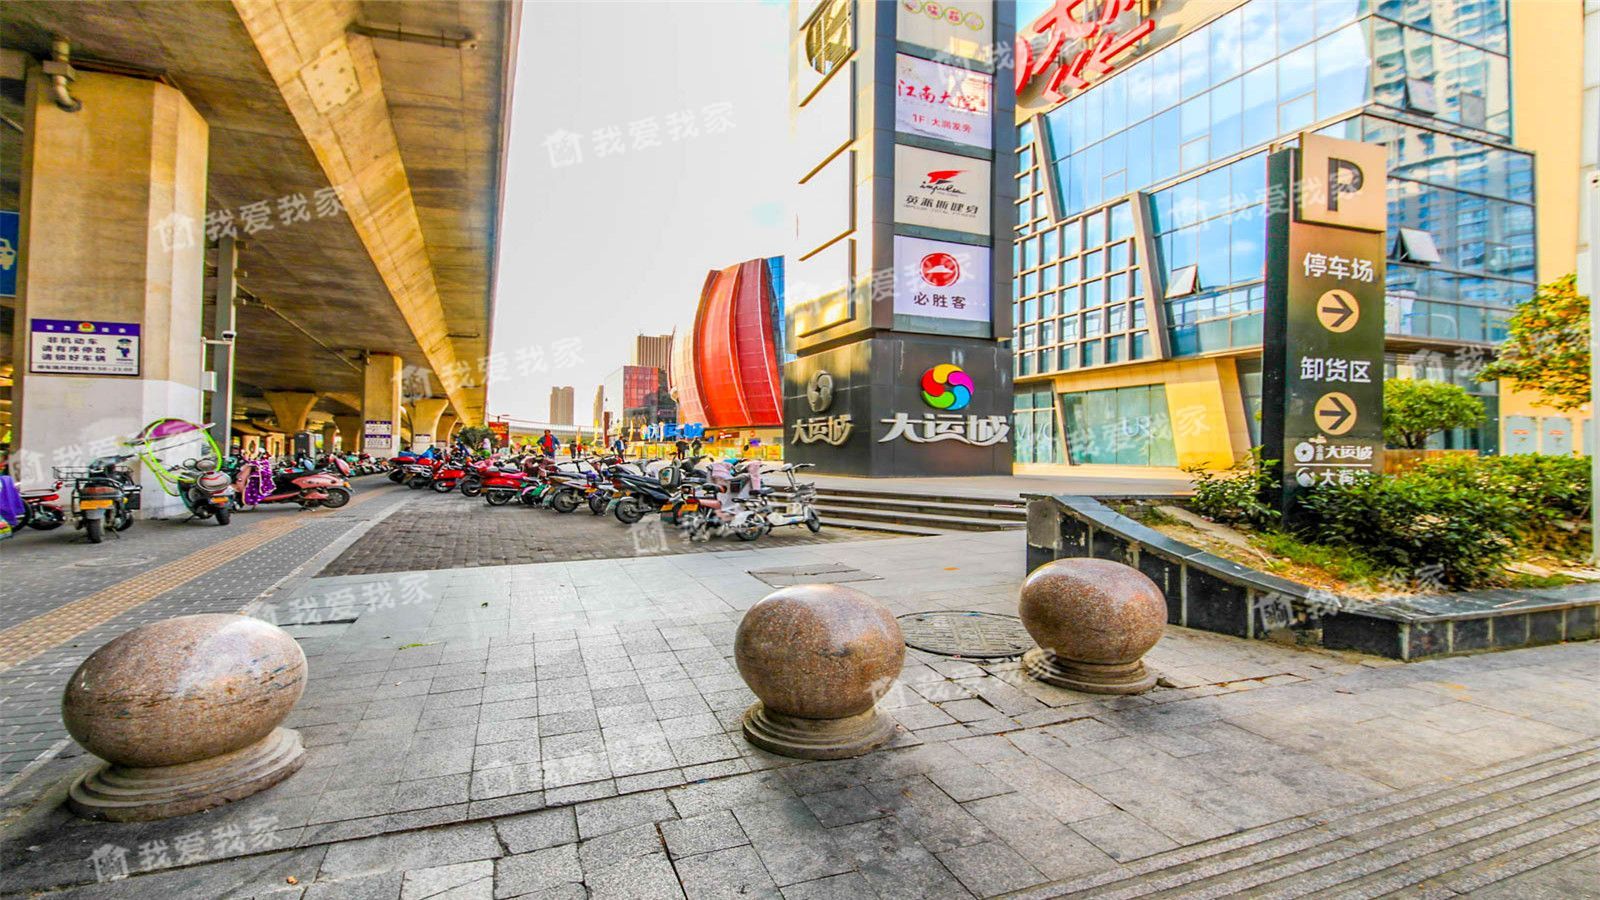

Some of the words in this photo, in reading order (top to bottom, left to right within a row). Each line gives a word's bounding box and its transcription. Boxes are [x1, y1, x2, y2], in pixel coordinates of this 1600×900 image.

[897, 79, 977, 112] 江南大院
[1327, 157, 1364, 212] P
[906, 195, 979, 215] 英派斯健身
[1303, 253, 1374, 282] 停车场
[914, 292, 966, 310] 必胜客
[1300, 356, 1372, 384] 卸货区
[791, 414, 853, 446] 大运城
[879, 413, 1010, 446] 大运城
[1325, 445, 1373, 461] 大运城
